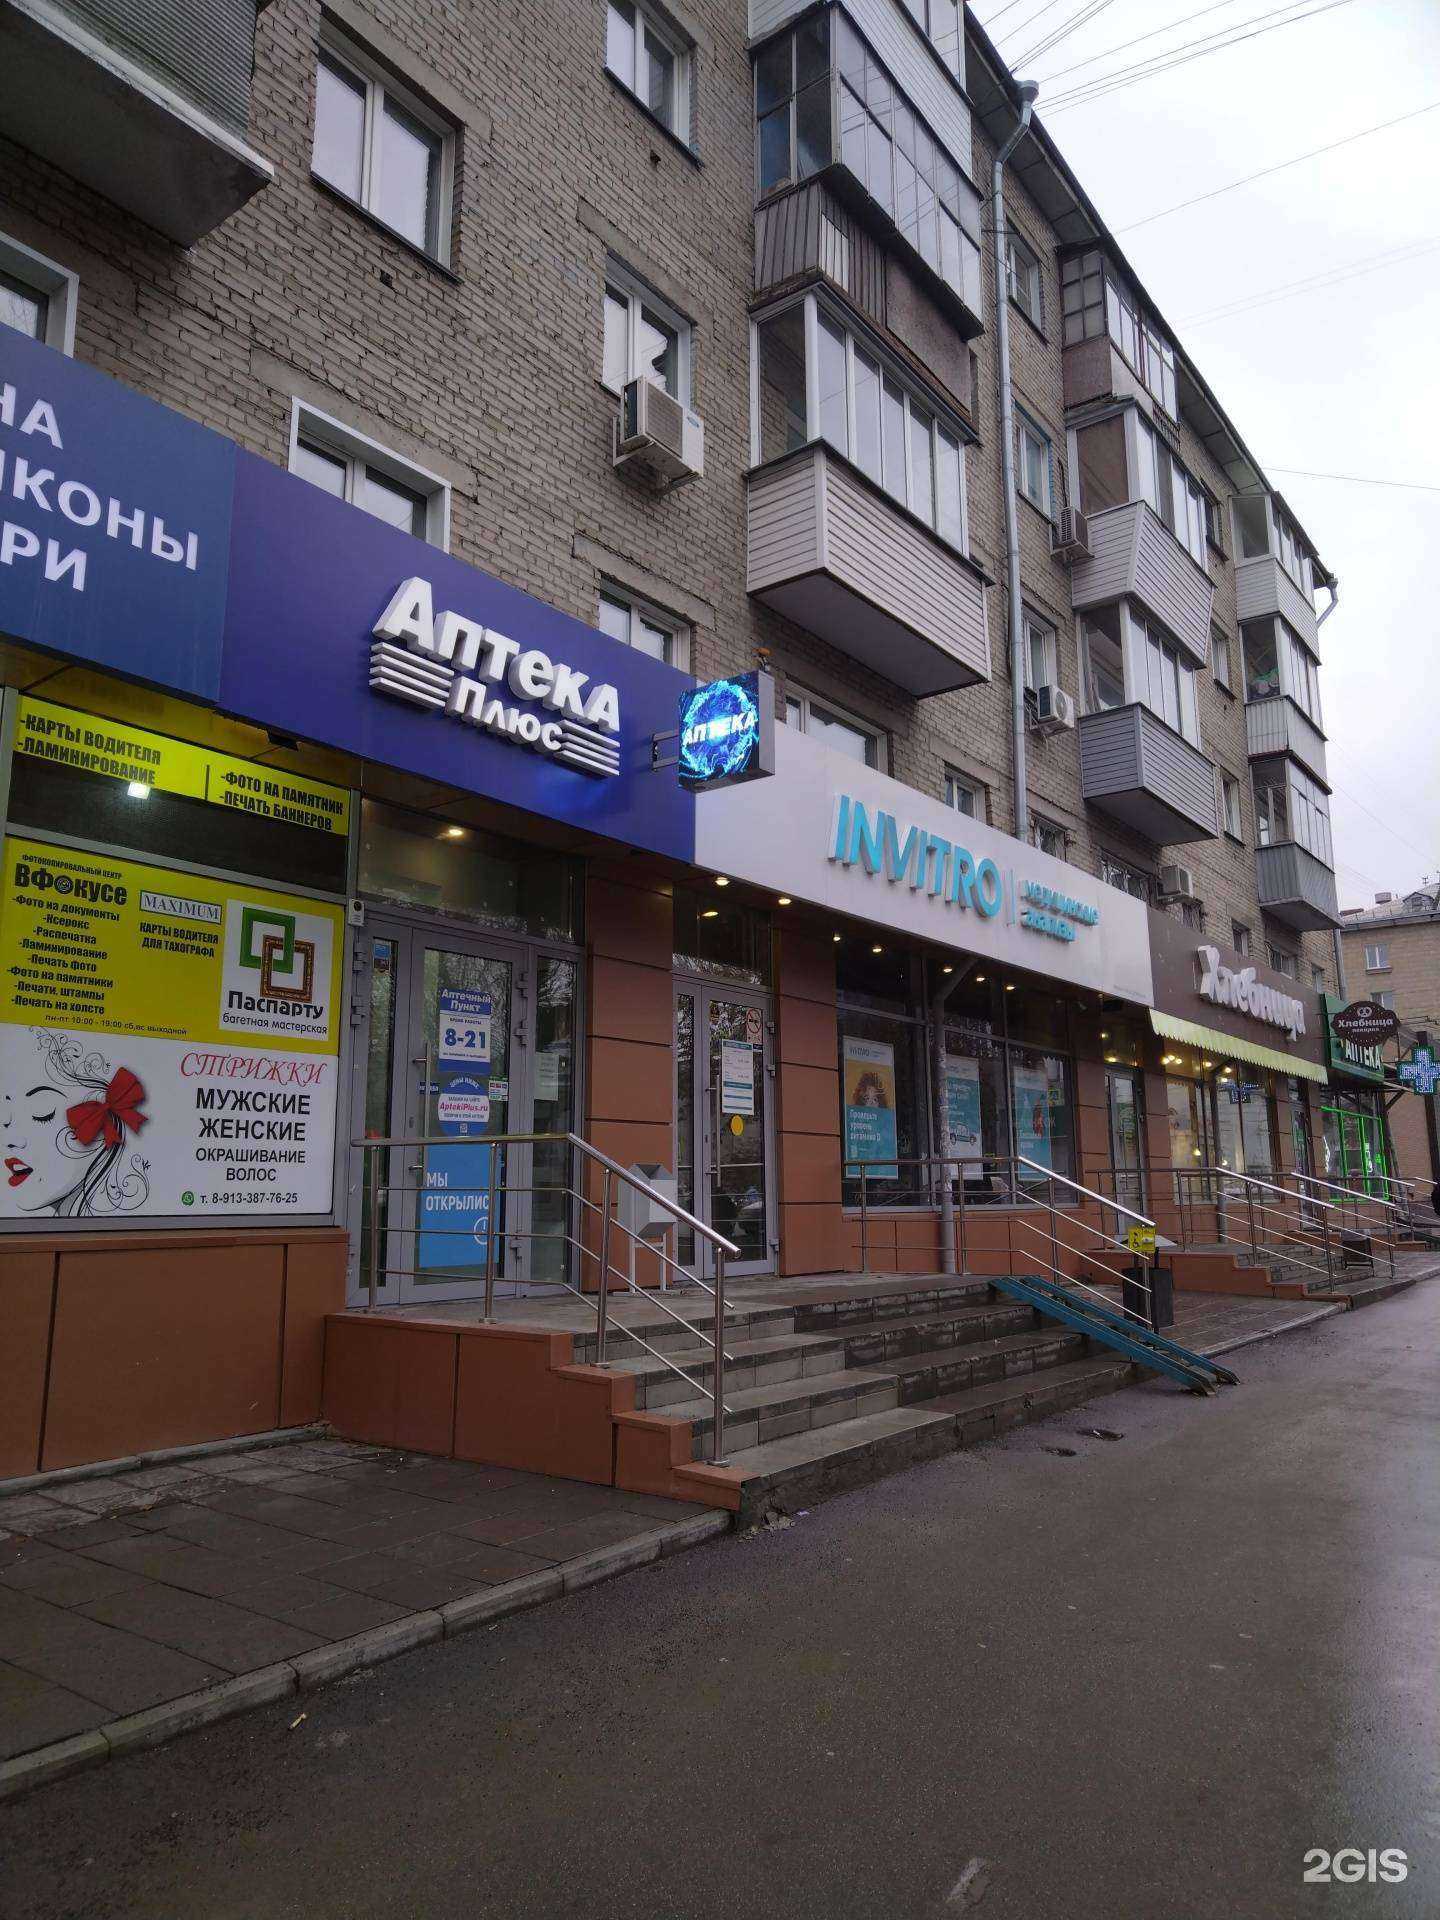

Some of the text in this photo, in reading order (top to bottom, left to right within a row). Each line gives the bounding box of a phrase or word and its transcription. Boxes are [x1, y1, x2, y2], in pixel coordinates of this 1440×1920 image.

[0, 448, 198, 571] КОНЫ
[84, 730, 161, 766] ВОДИТЕЛЯ
[264, 781, 279, 798] НА
[282, 785, 343, 815] ПАМЯТНИК
[273, 804, 332, 831] БАННЕРОВ
[829, 794, 1001, 918] INVITRO
[46, 900, 59, 912] на
[60, 904, 120, 922] документы
[143, 894, 220, 920] MAXIMUM
[140, 922, 218, 945] КАРТЫ ВОДИТЕЛЯ
[142, 936, 215, 958] ДЛЯ ТАХОГРАФА
[70, 957, 97, 972] фото
[41, 968, 55, 980] на
[56, 972, 114, 989] памятники
[55, 999, 68, 1012] на
[228, 990, 324, 1020] Паспарту
[441, 988, 491, 1004] Аптечный
[450, 999, 481, 1012] Пункт
[222, 1012, 327, 1035] багетная мастерская
[1338, 1017, 1393, 1028] Хлебница
[444, 1027, 486, 1049] 8-21
[180, 1052, 327, 1086] СТРИЖКИ
[196, 1087, 311, 1115] МУЖСКИЕ
[440, 1101, 489, 1112] AptekiPlus.ru
[199, 1117, 306, 1141] ЖЕНСКИЕ
[195, 1148, 306, 1164] ОКРАШИВАНИЕ
[226, 1167, 277, 1182] ВОЛОС
[426, 1172, 448, 1188] МЫ
[211, 1191, 298, 1204] 8-913-387-76-25
